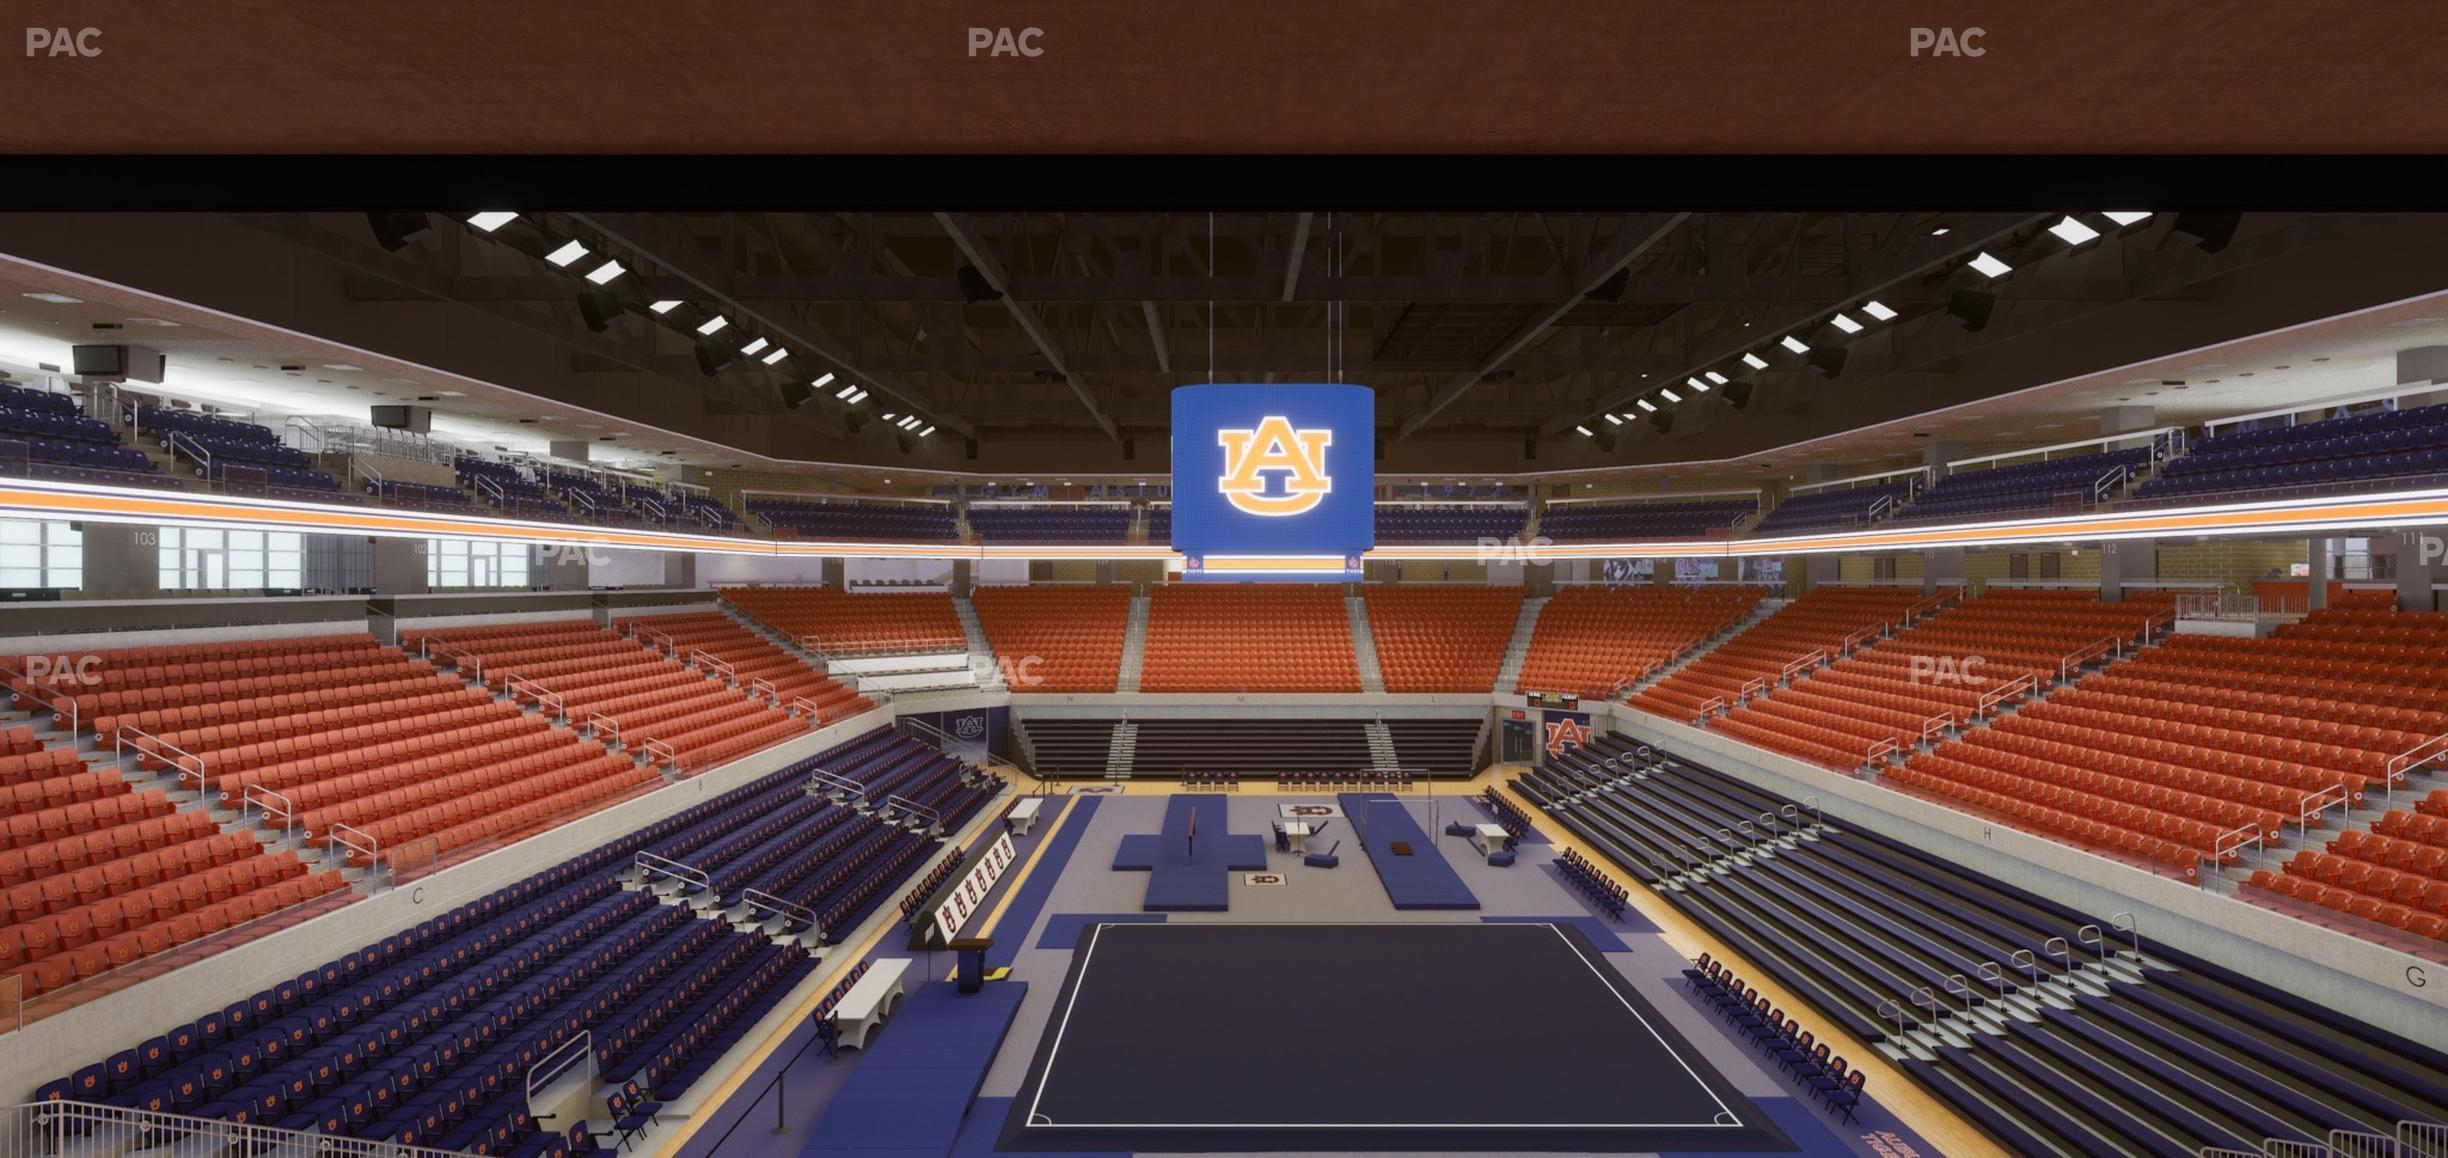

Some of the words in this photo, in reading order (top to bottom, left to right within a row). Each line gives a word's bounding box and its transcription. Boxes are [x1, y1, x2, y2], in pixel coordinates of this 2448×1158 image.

[134, 532, 155, 545] 103
[2402, 531, 2423, 545] 111
[415, 543, 426, 554] 102
[2103, 544, 2117, 554] 112
[1984, 826, 1991, 841] H
[412, 886, 424, 905] C
[2406, 965, 2426, 988] G
